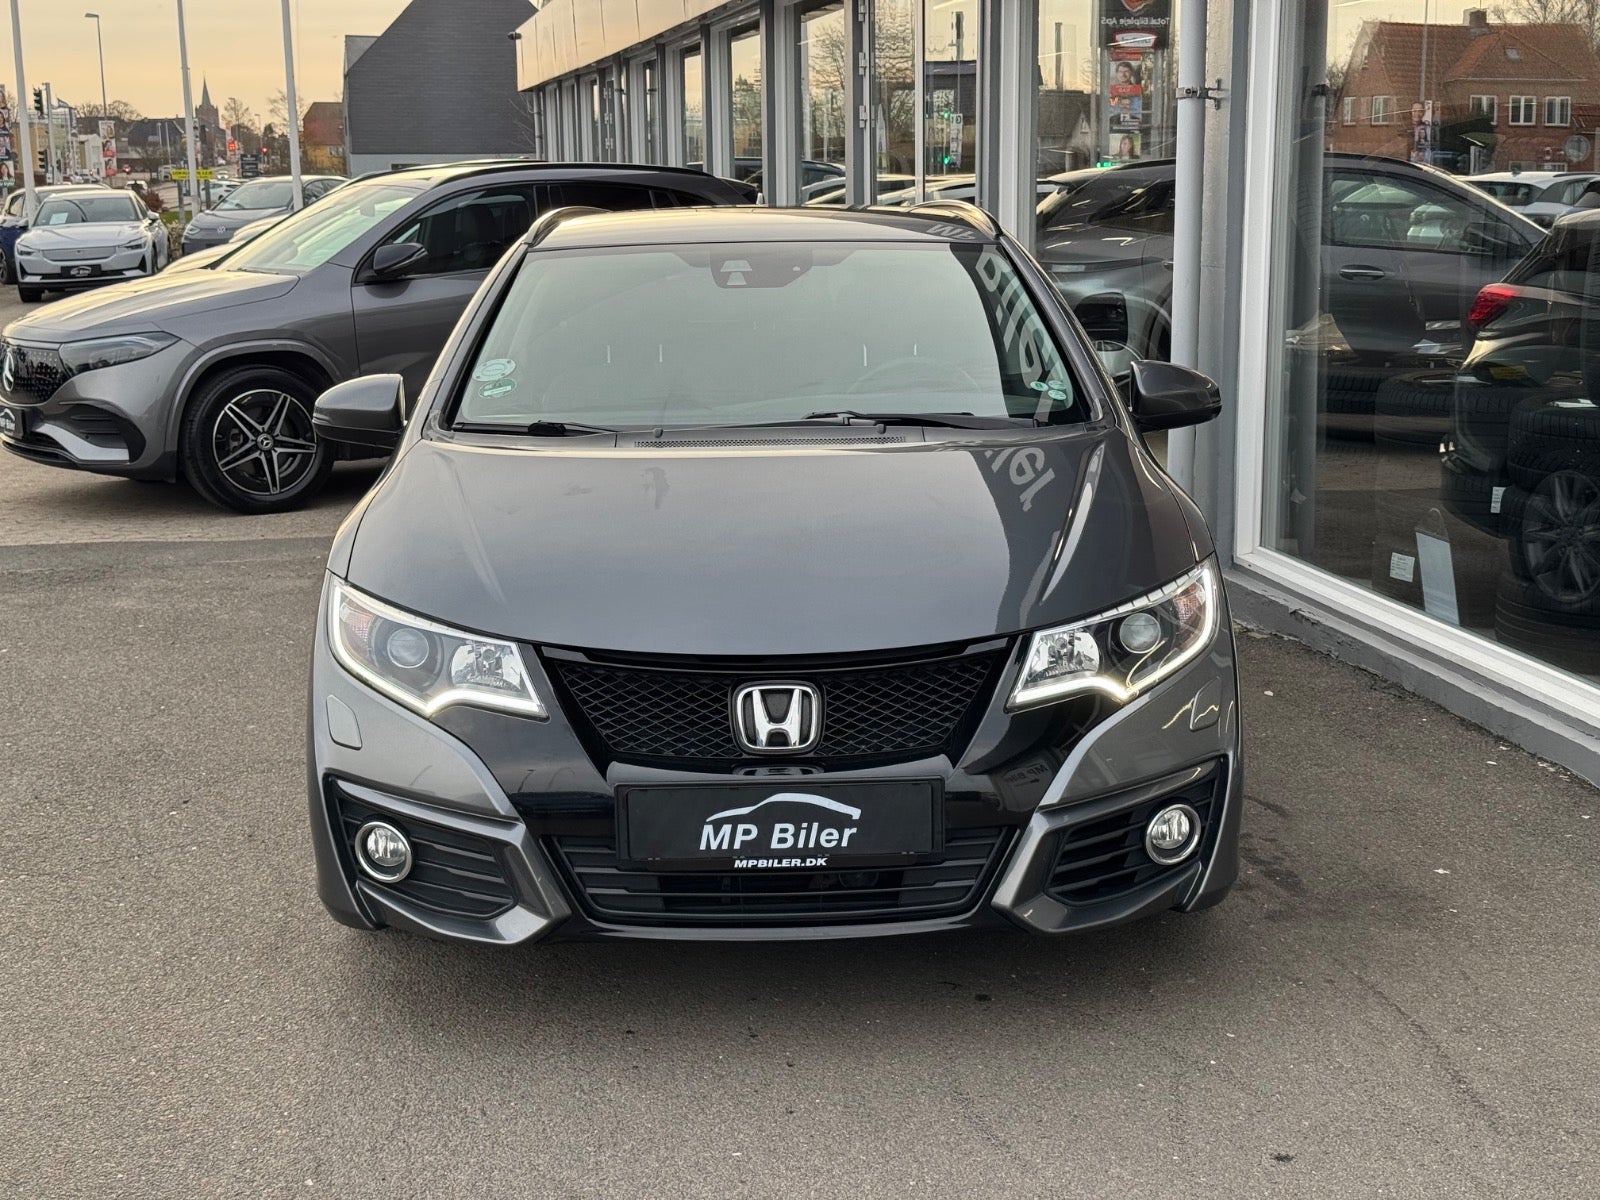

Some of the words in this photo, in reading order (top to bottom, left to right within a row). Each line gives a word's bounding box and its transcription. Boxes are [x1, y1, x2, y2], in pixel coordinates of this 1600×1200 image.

[699, 823, 758, 851] MP
[770, 822, 858, 849] Biler
[734, 857, 828, 869] MPBILER.DK
